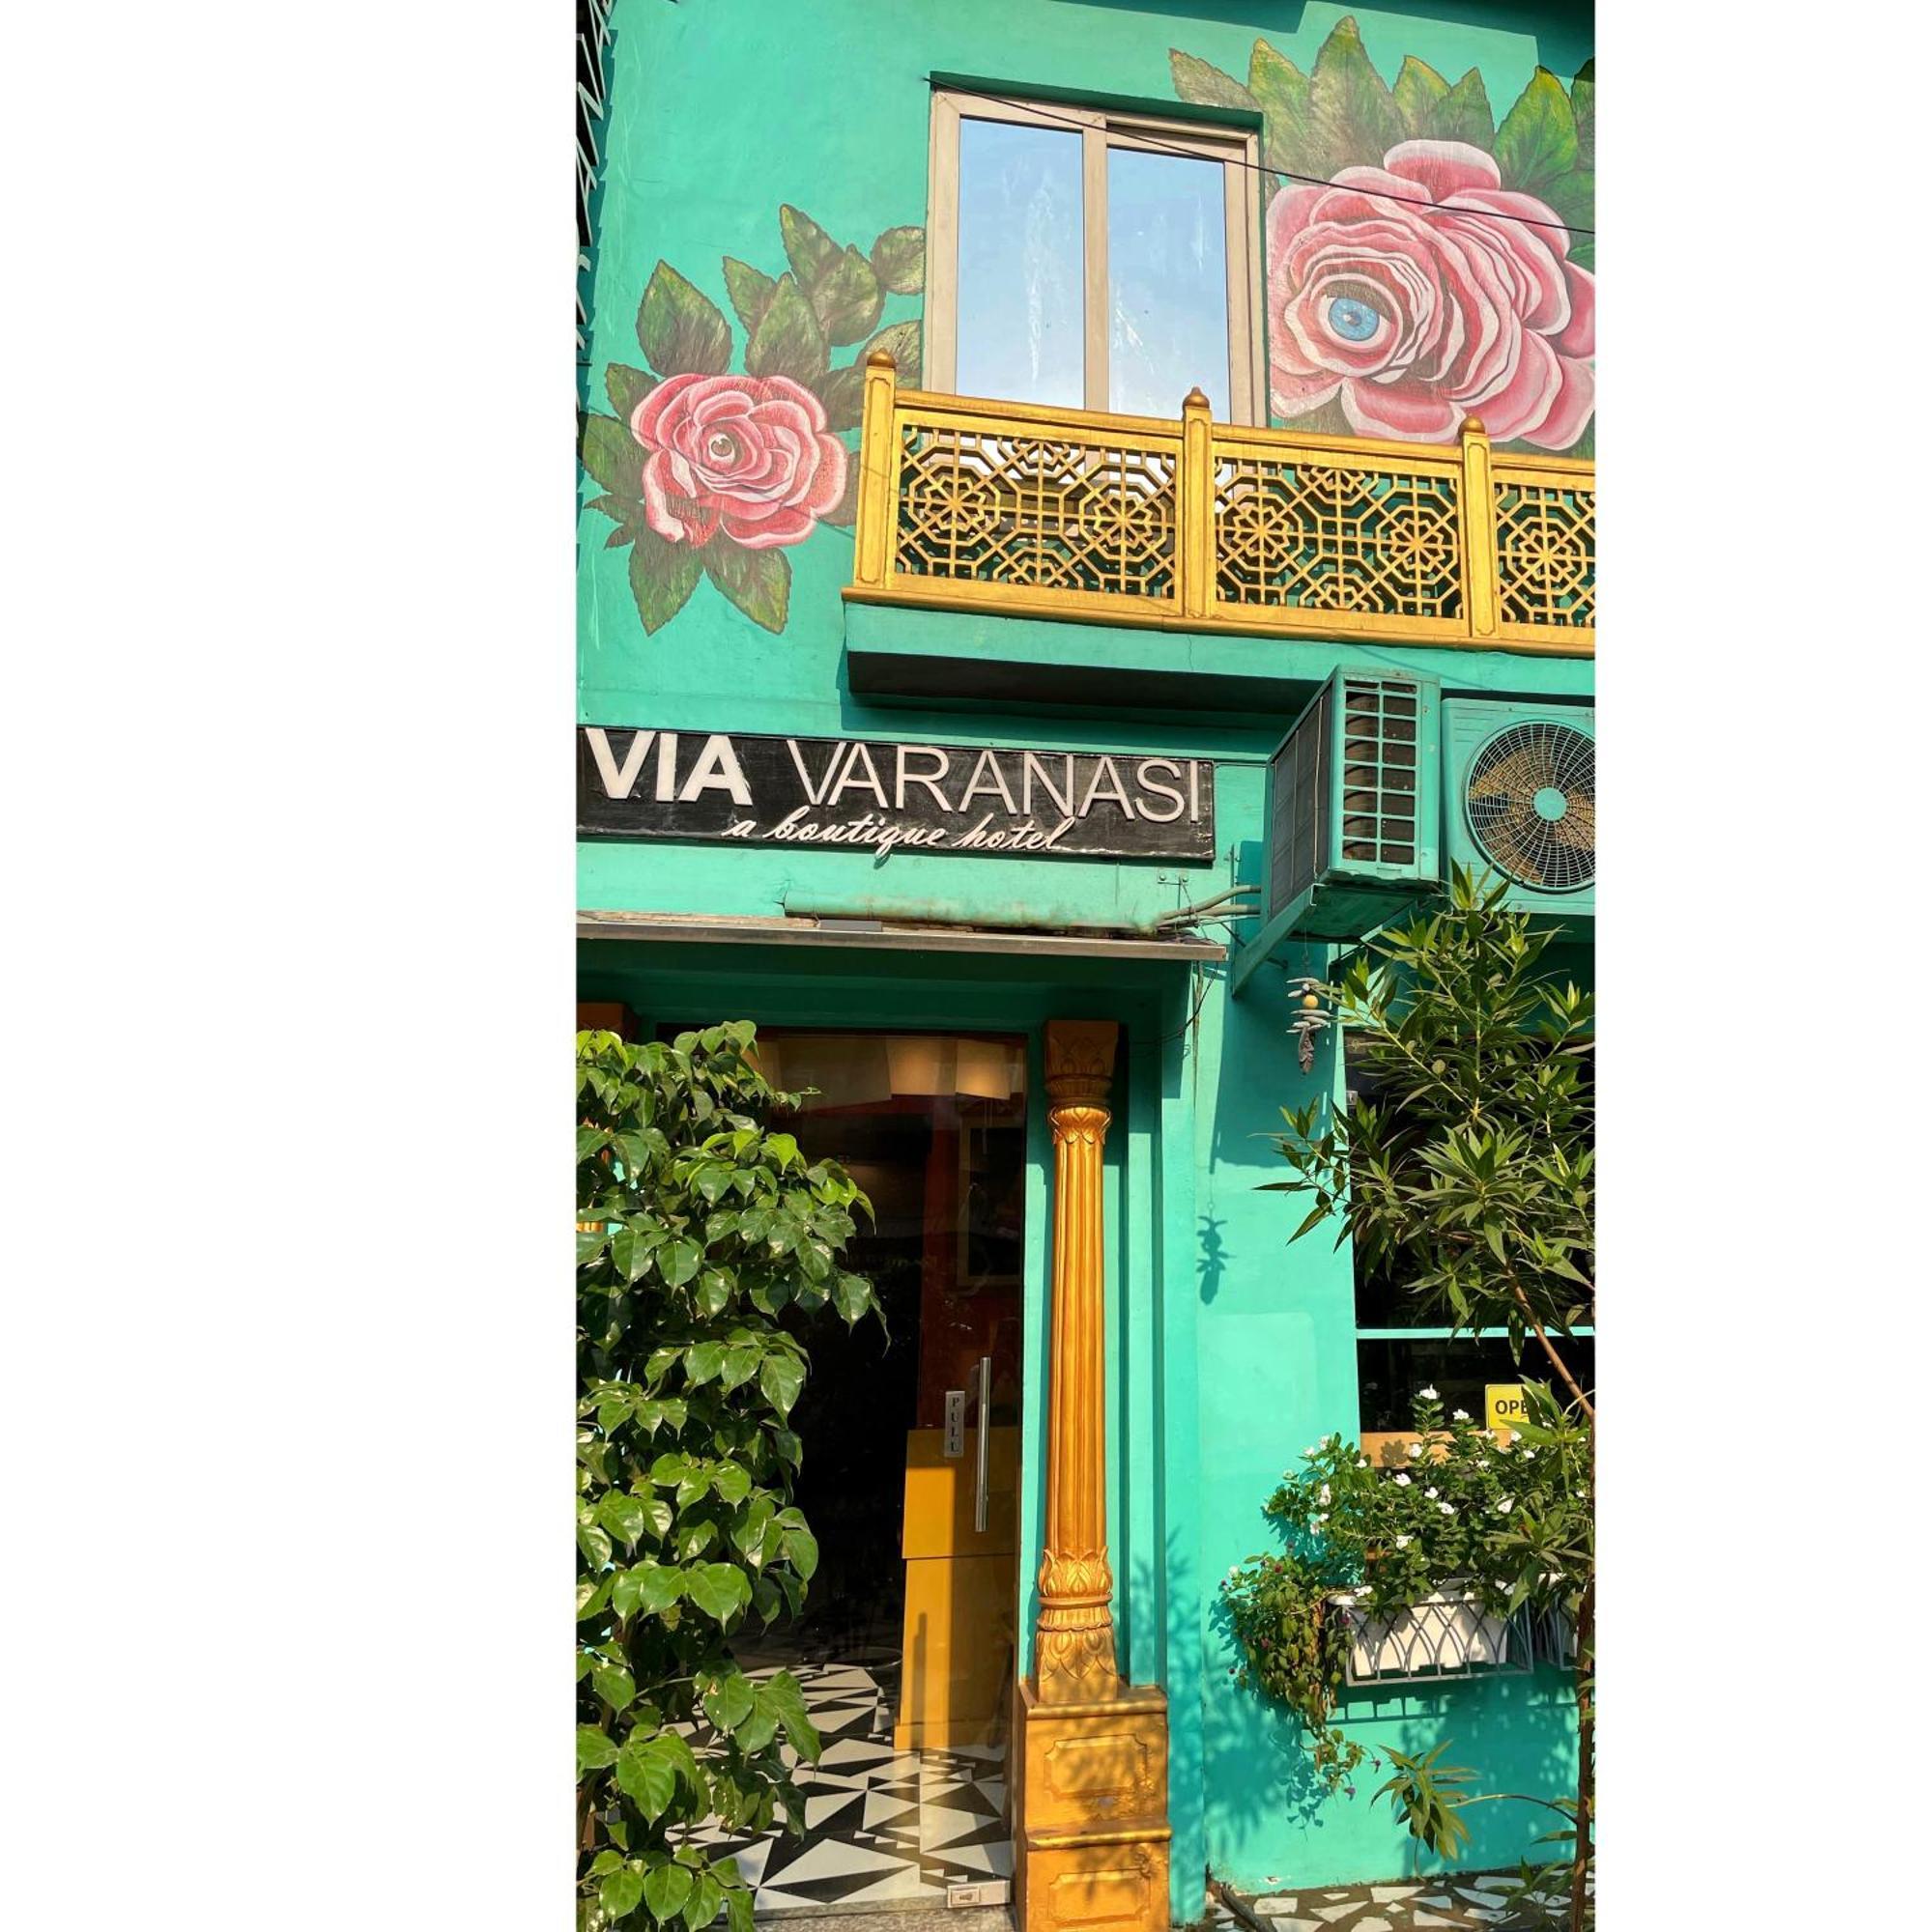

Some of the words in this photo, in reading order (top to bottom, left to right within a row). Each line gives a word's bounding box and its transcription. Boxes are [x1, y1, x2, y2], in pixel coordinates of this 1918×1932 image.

[586, 727, 753, 806] VIA
[787, 740, 1198, 822] VARANASI
[721, 820, 757, 838] a
[762, 806, 946, 859] boutique
[952, 812, 1075, 850] hotel
[951, 1397, 959, 1453] PULL
[1495, 1400, 1529, 1414] OPE
